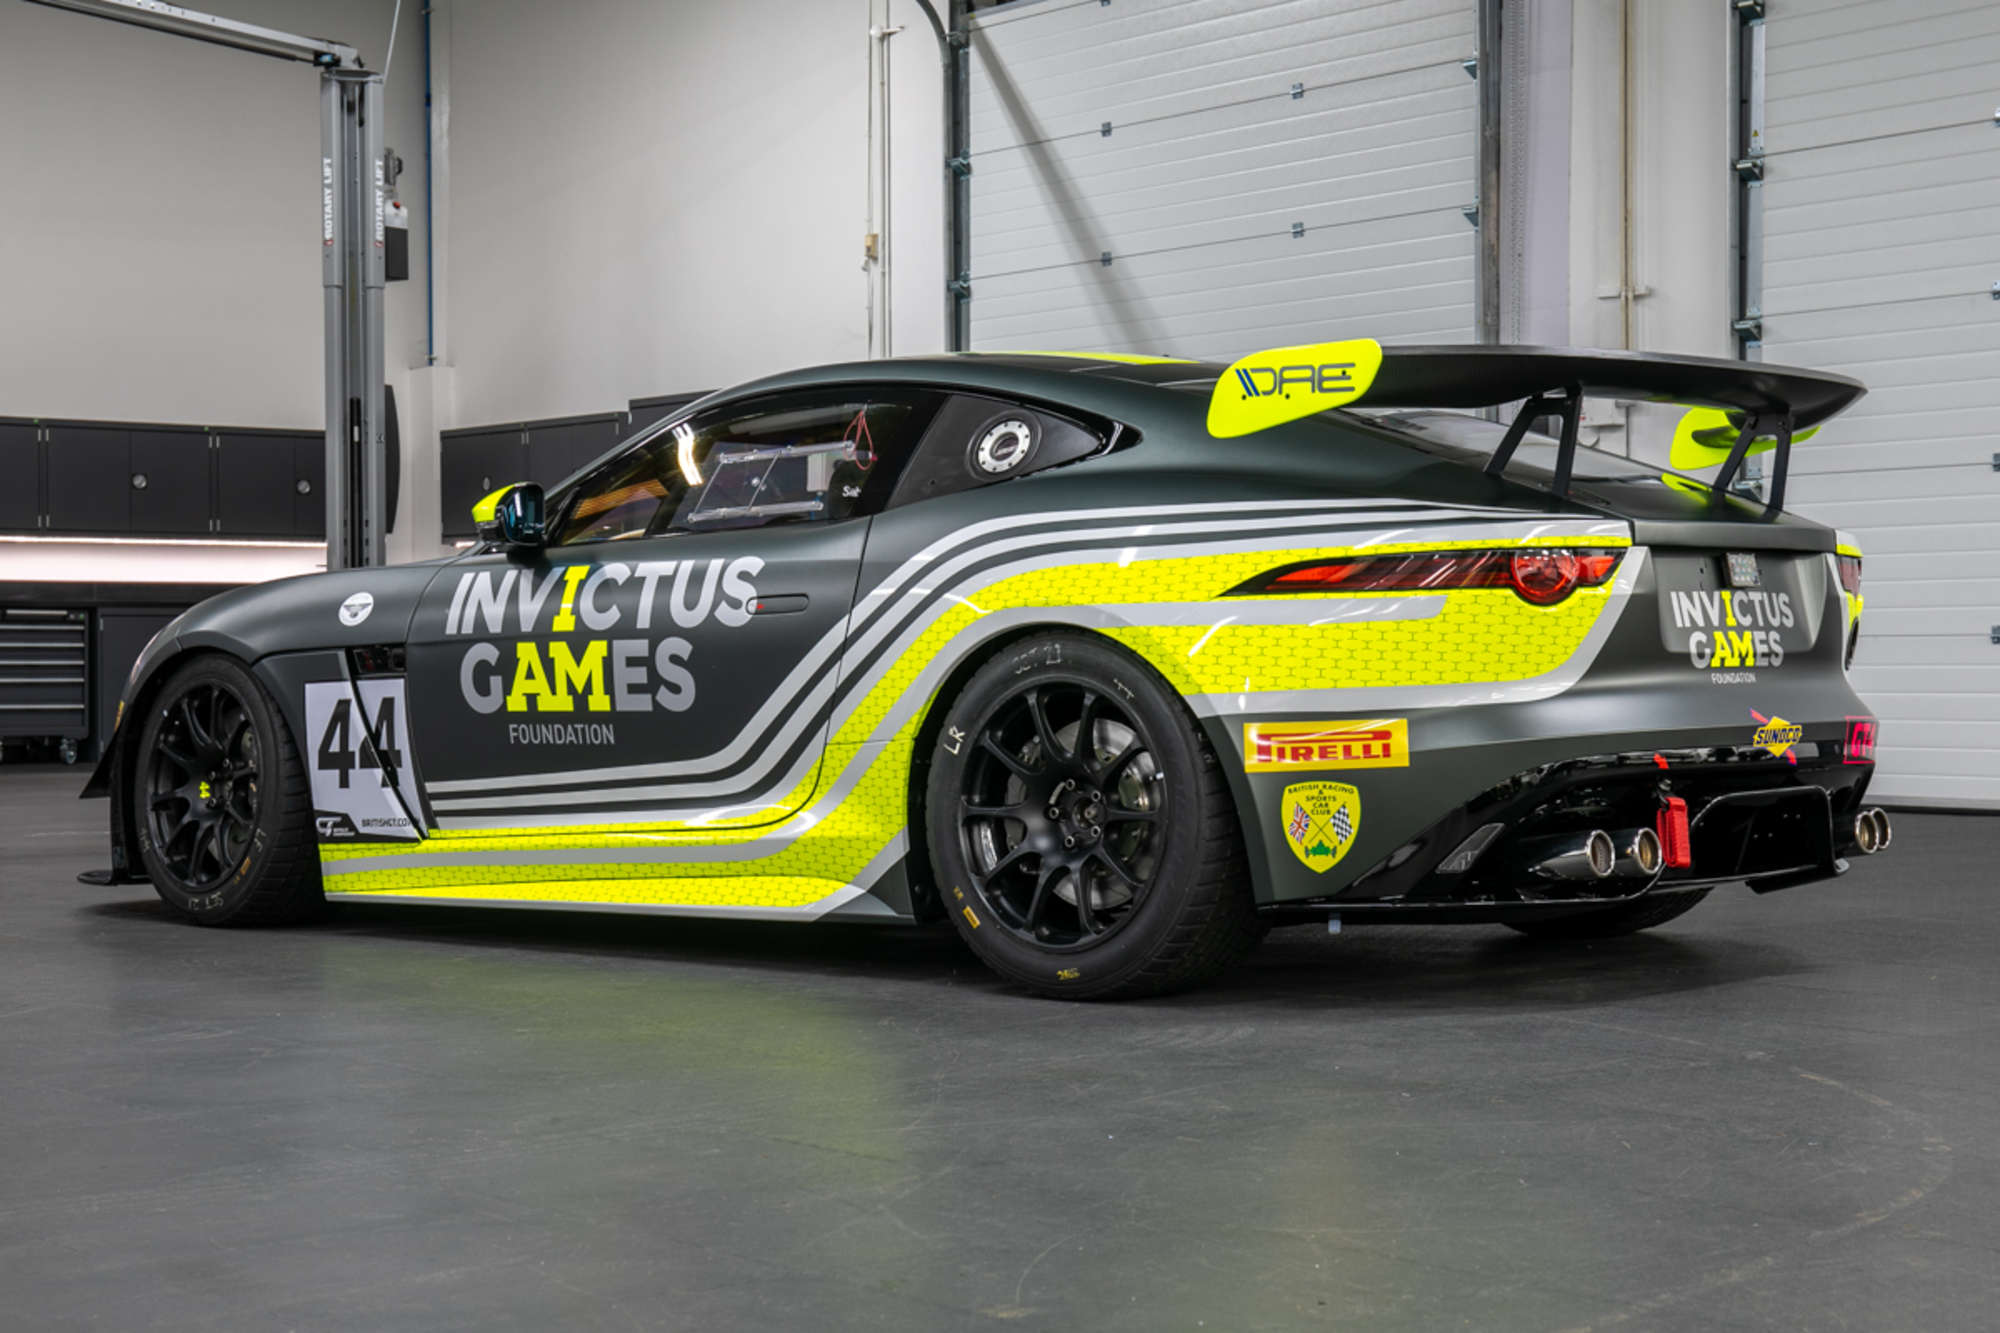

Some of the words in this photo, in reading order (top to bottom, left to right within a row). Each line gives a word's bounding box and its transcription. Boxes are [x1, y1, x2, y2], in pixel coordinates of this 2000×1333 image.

[323, 157, 333, 184] LIFT
[375, 159, 384, 186] LIFT
[323, 187, 333, 240] ROTARY
[375, 189, 384, 241] ROTARY
[445, 555, 766, 635] INVICTUS
[1670, 590, 1795, 629] INVICTUS
[1689, 630, 1785, 669] GAMES
[459, 636, 696, 715] GAMES
[1711, 672, 1756, 684] FOUNDATION
[318, 696, 402, 789] 44
[508, 723, 616, 745] FOUNDATION
[1256, 730, 1392, 763] PIRELLI
[1756, 727, 1801, 744] SUNOCO
[1288, 784, 1320, 795] BRITISH
[1322, 783, 1355, 795] RACING
[1310, 808, 1331, 816] CLUB
